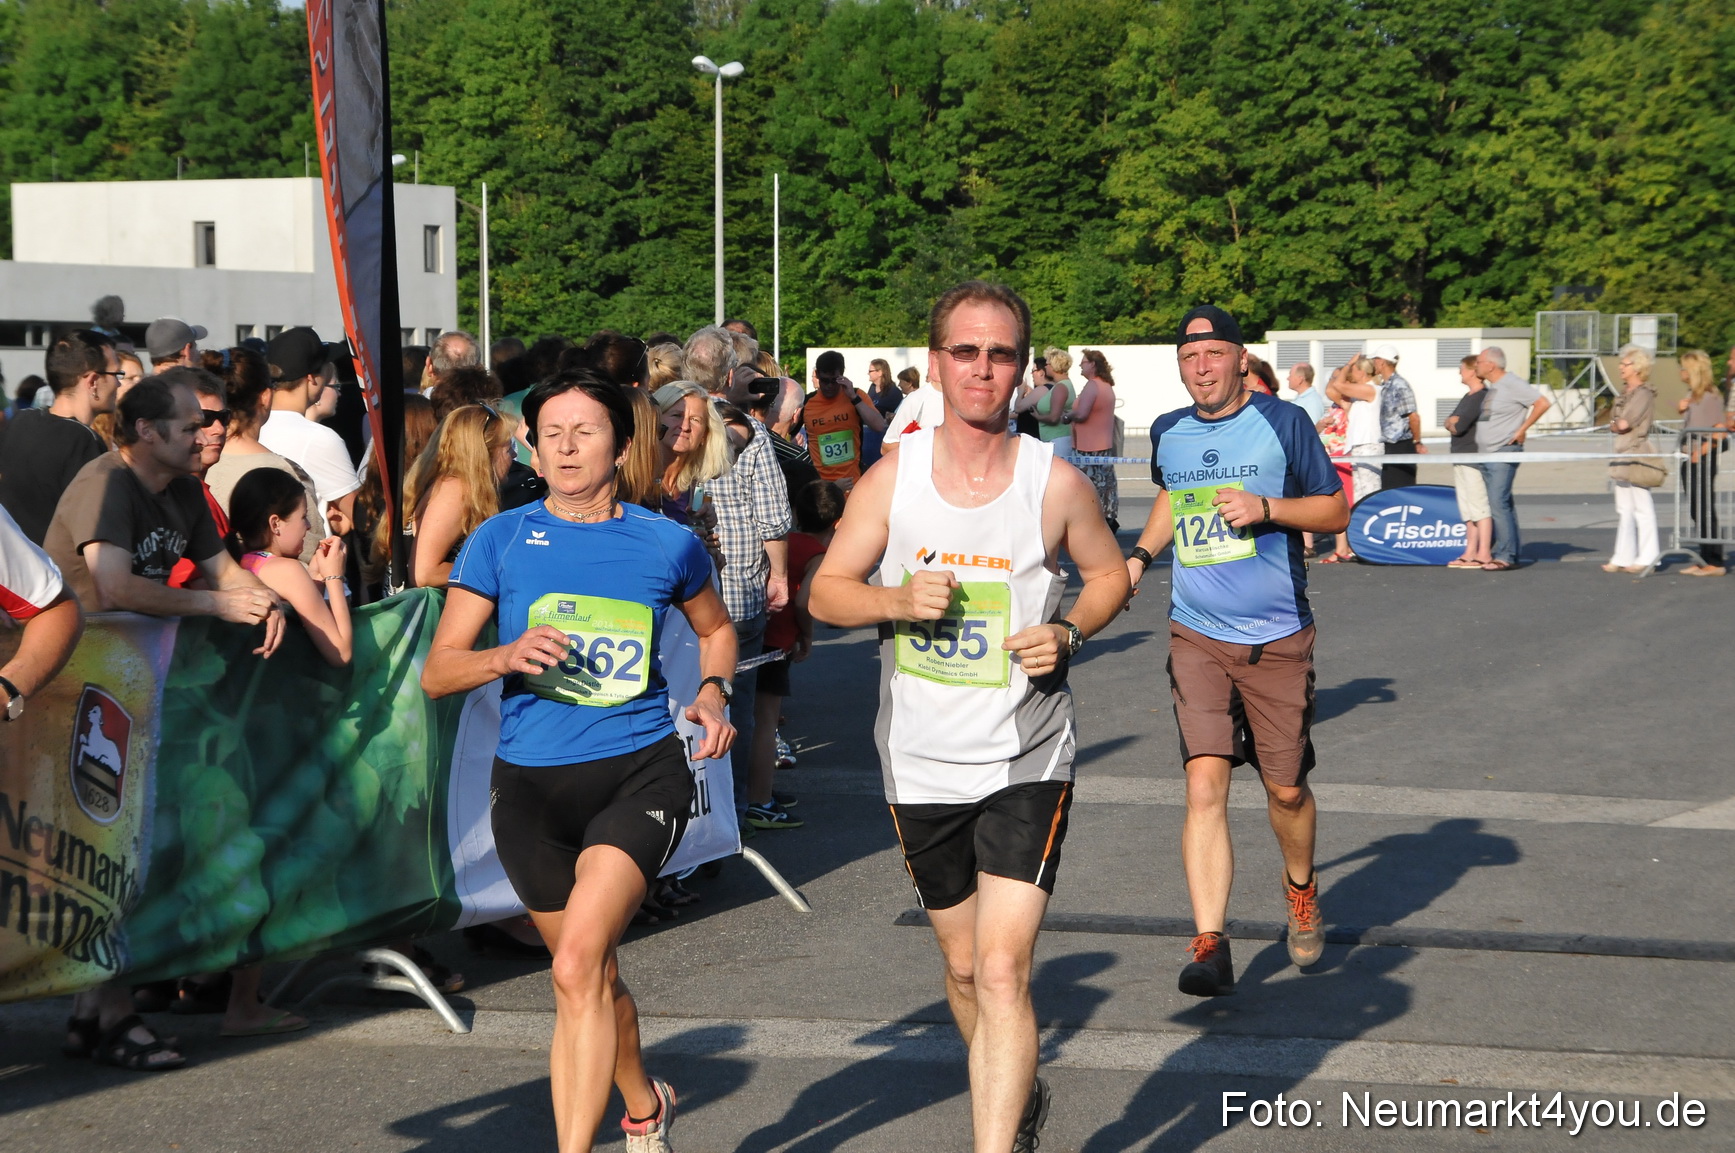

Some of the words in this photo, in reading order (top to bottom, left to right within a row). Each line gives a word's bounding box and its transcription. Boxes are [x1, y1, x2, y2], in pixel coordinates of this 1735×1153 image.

[812, 417, 825, 427] PE
[834, 413, 849, 423] KU
[825, 442, 848, 458] 931
[1167, 464, 1259, 484] SCHABMÜLLER
[1384, 520, 1467, 540] Fische
[525, 538, 550, 546] erima
[941, 552, 1013, 572] KLEBL
[548, 611, 592, 623] firmenlauf
[909, 619, 988, 660] 555
[541, 634, 643, 682] 862
[926, 656, 944, 667] Robert
[945, 661, 969, 669] Niebler
[918, 663, 931, 673] Klebl
[931, 667, 958, 677] Dynamics
[84, 784, 110, 813] 1628
[0, 792, 138, 904] Neumark
